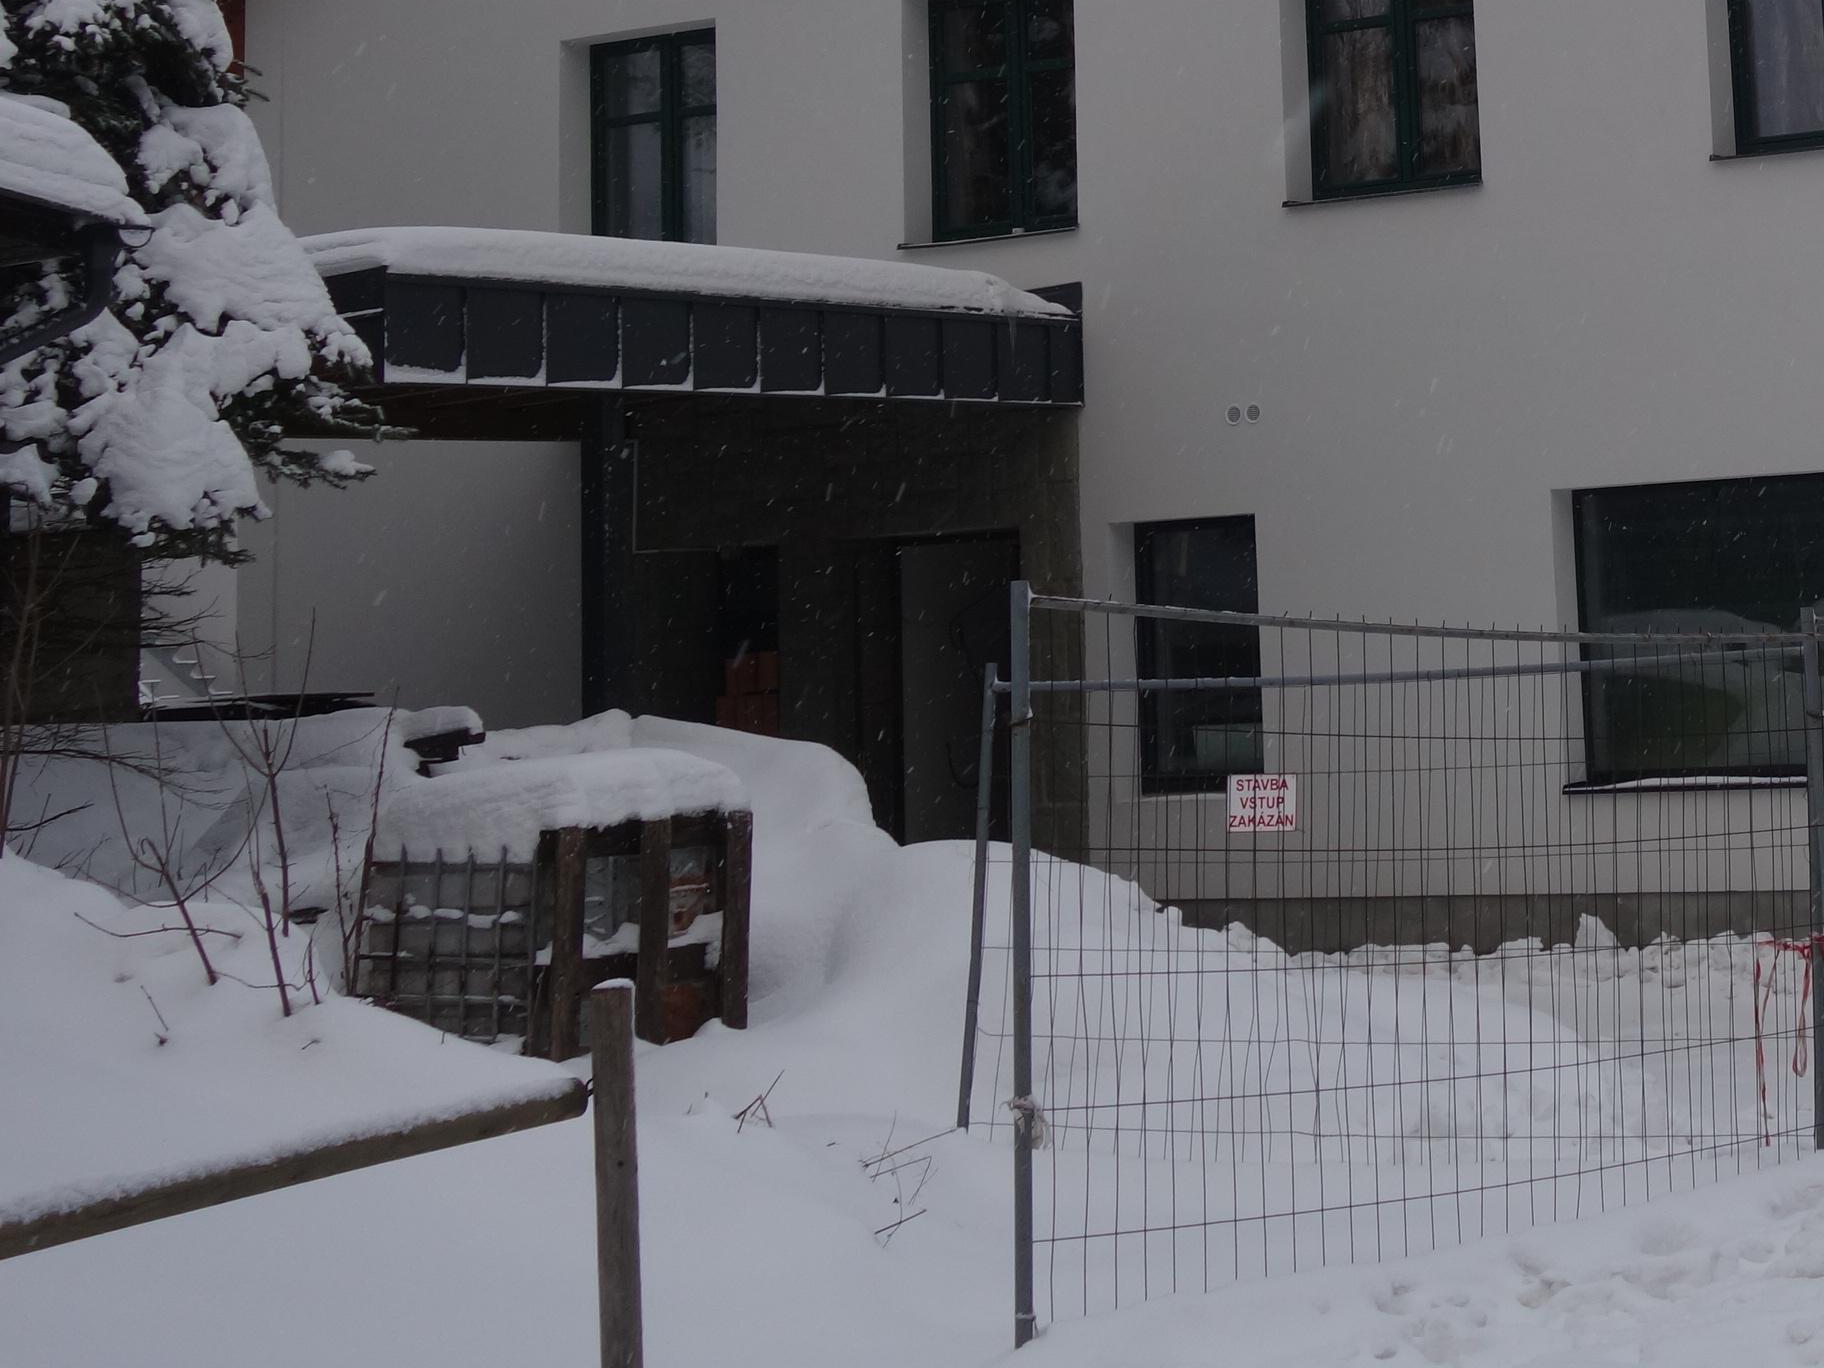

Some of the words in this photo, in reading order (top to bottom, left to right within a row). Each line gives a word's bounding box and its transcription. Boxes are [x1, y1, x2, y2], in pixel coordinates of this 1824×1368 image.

[1236, 779, 1288, 791] STAVBA
[1240, 797, 1285, 809] VSTUP
[1229, 812, 1294, 827] ZAKÁZÁN
